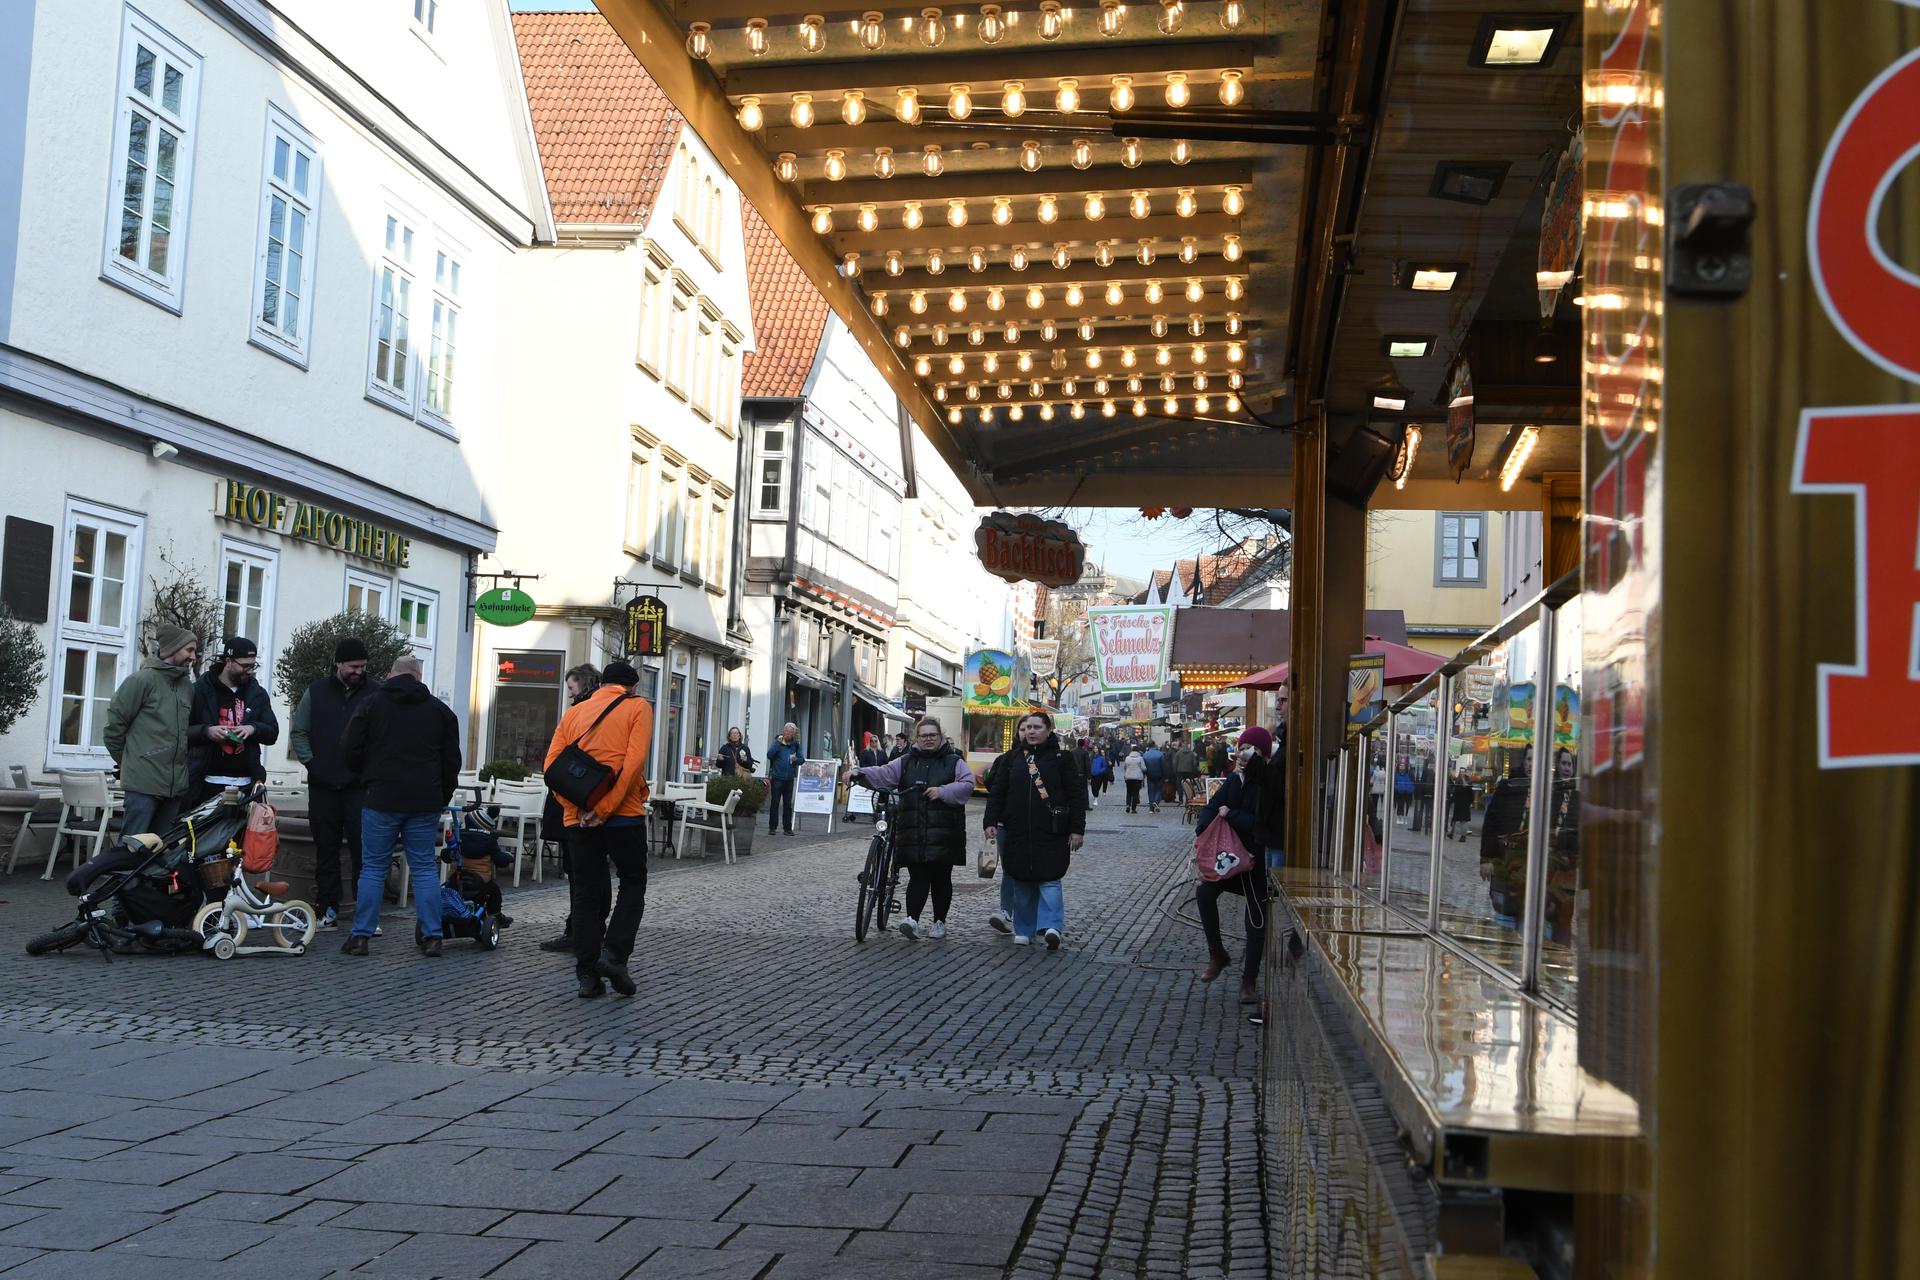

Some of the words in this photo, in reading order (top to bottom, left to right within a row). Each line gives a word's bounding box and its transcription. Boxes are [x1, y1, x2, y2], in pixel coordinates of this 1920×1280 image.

[225, 479, 286, 529] HOF
[291, 501, 411, 567] APOTHEKE
[984, 527, 1075, 577] Backfisch
[1110, 614, 1150, 630] Frische
[1099, 628, 1163, 656] Schmalz-
[1105, 656, 1157, 683] kuchen
